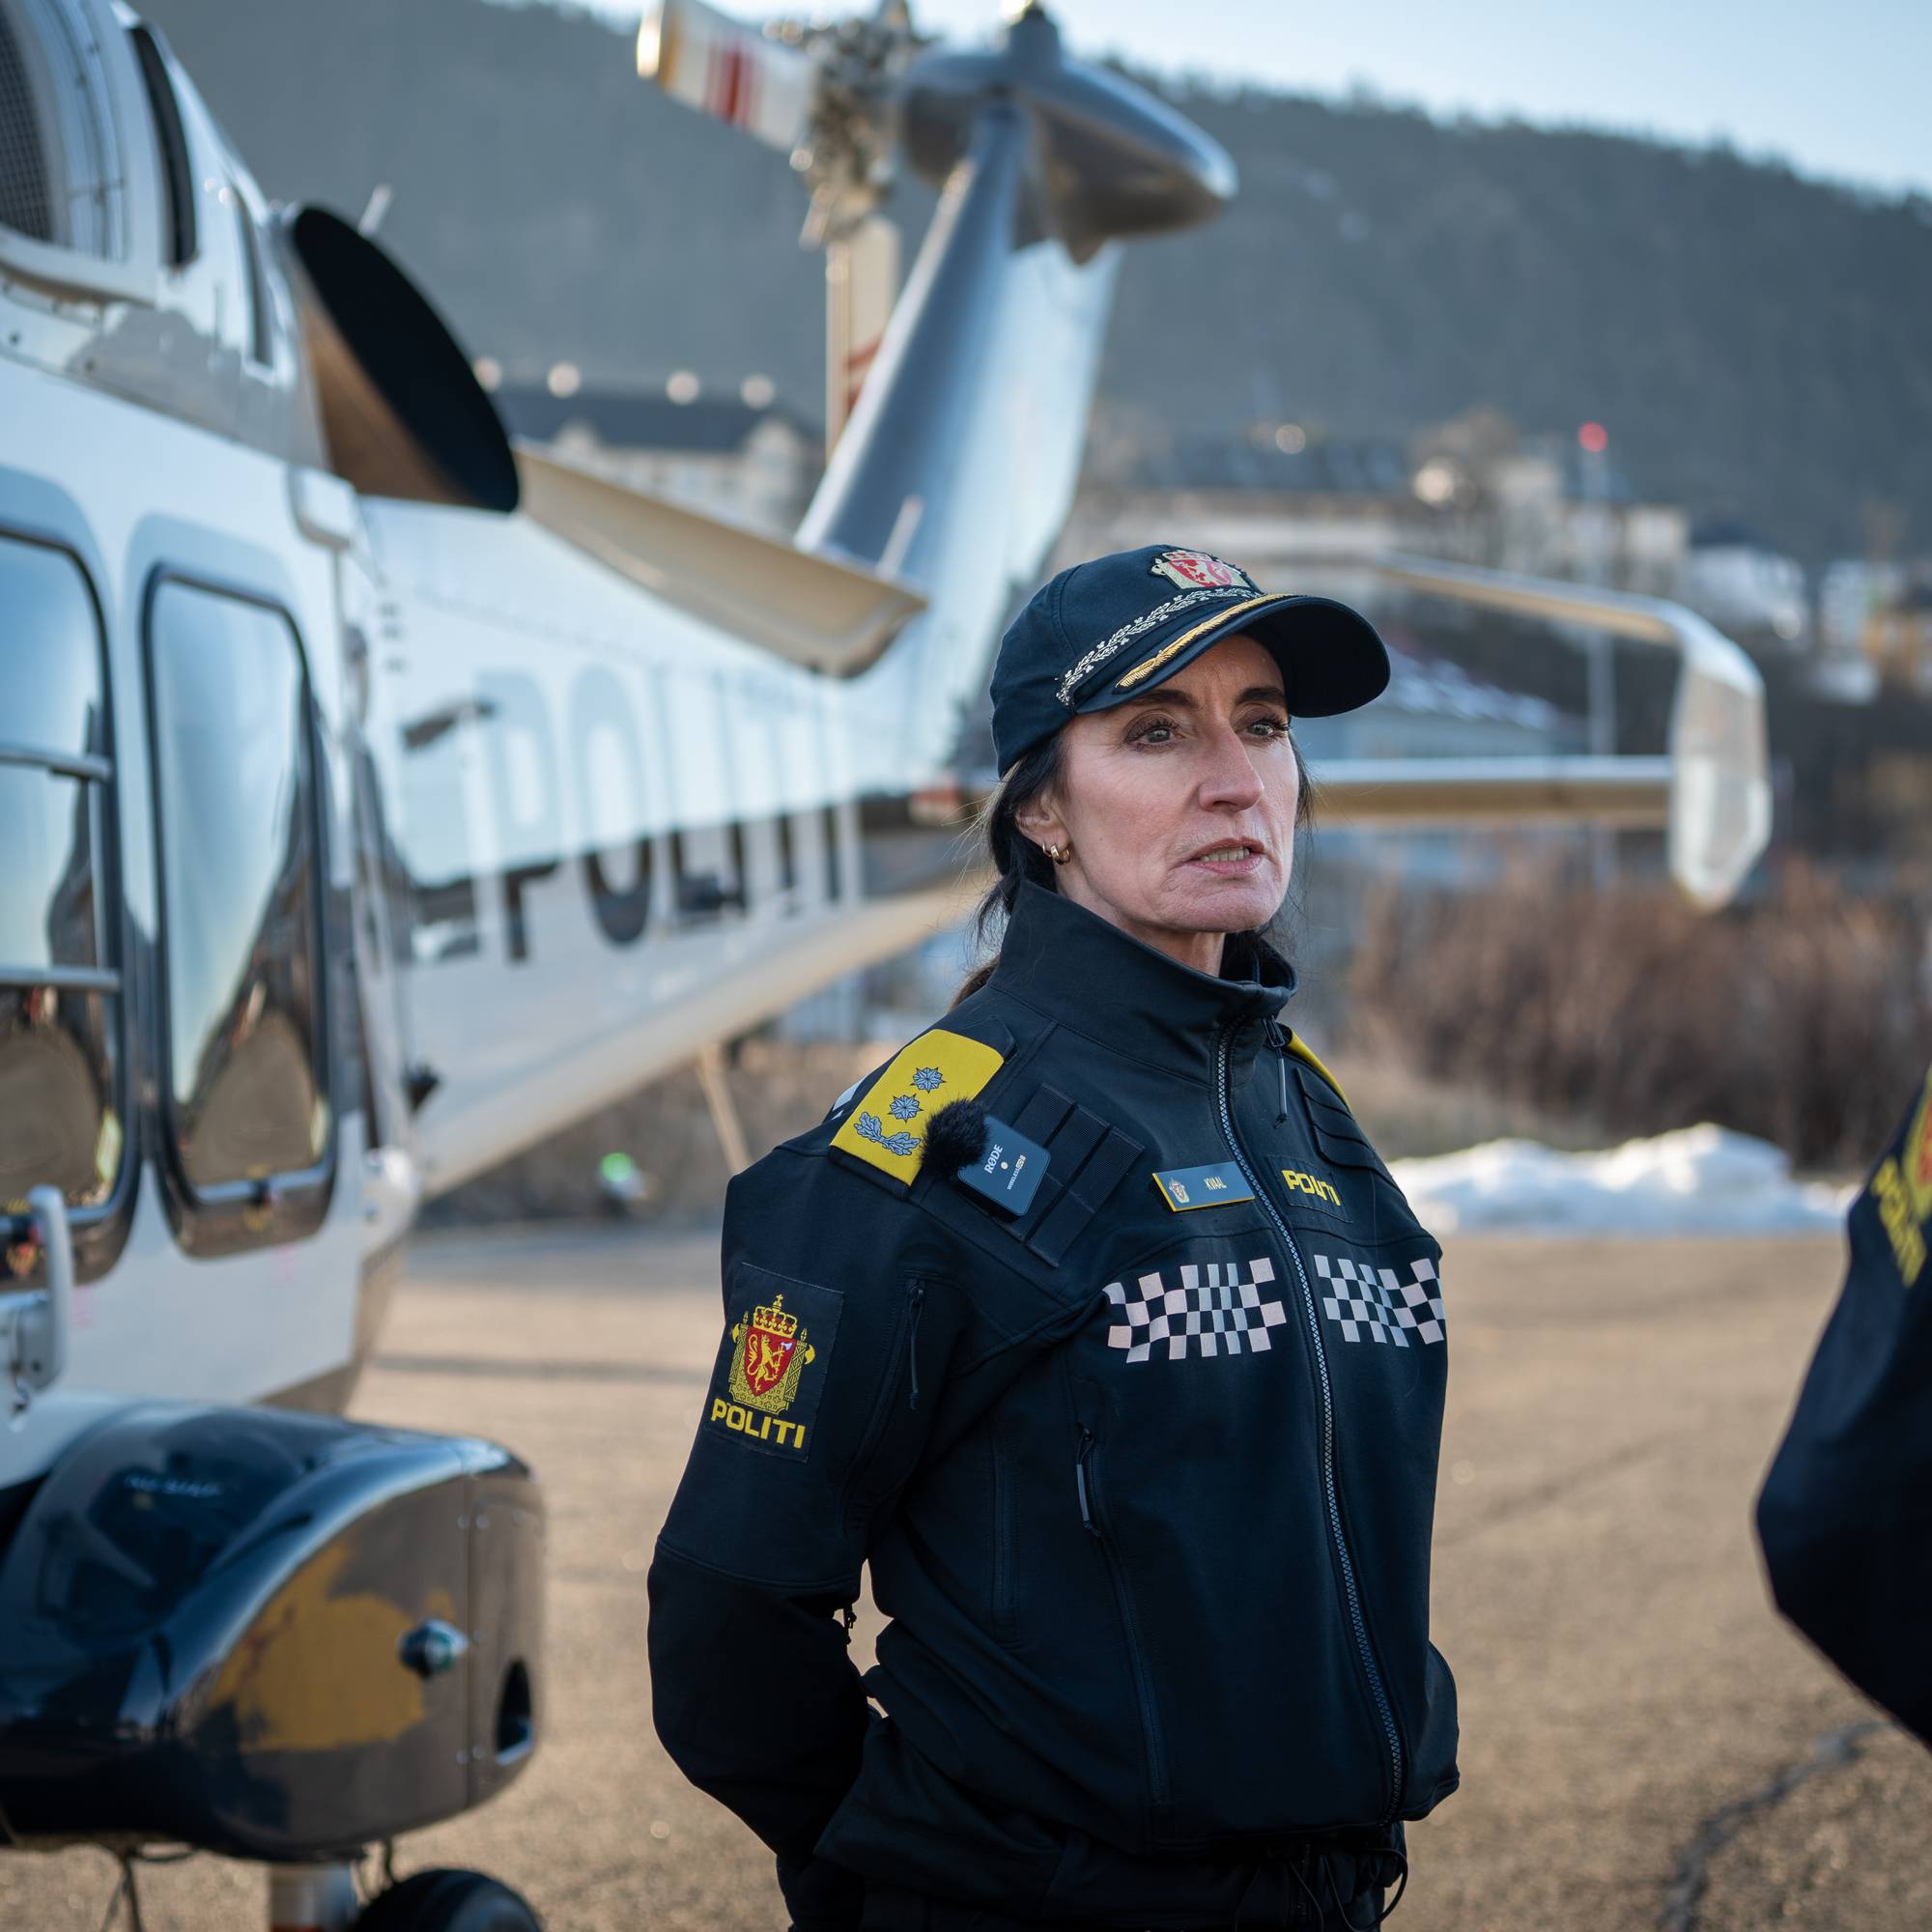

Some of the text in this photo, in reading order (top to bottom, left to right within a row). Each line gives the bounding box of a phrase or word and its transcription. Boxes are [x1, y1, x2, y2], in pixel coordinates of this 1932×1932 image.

[474, 667, 841, 962] POLITI
[1282, 1170, 1341, 1206] POLITI
[711, 1398, 806, 1449] POLITI
